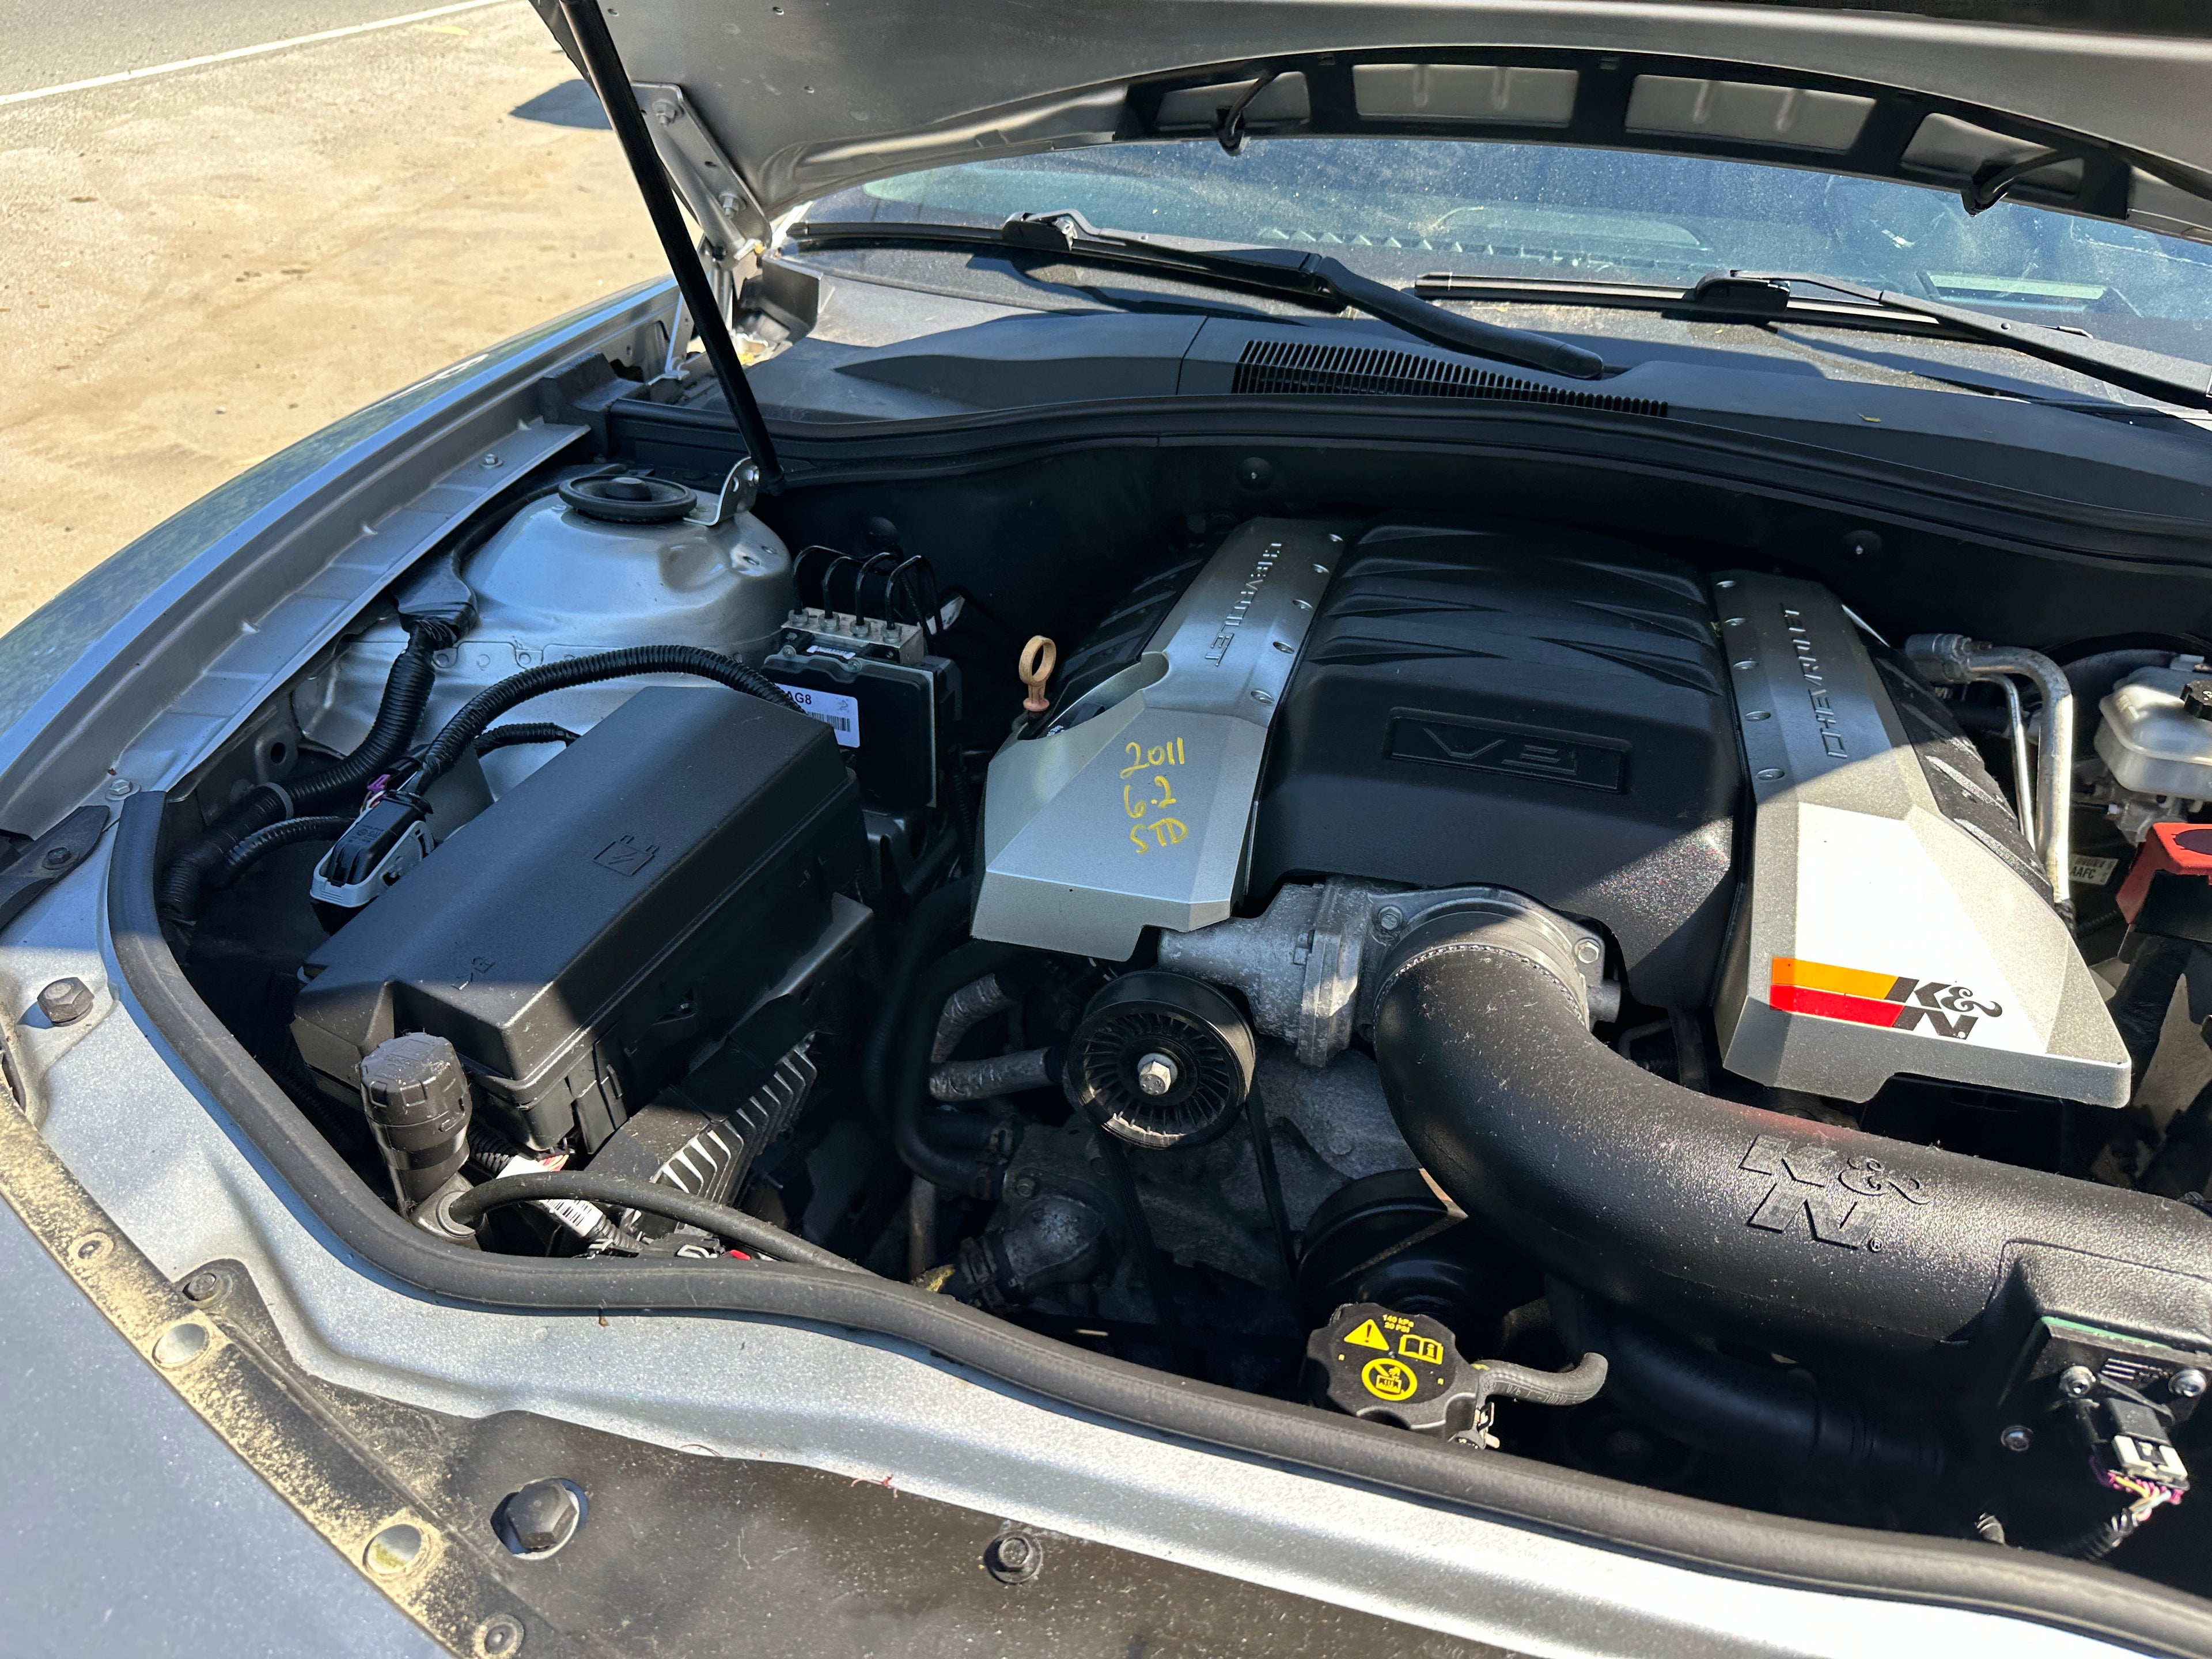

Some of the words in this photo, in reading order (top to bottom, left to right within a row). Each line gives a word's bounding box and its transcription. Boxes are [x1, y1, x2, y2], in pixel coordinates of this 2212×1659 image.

[1205, 543, 1282, 667] CHEVROLET
[1779, 603, 1848, 759] CHEVROLET
[1120, 737, 1184, 779] 2011
[1124, 775, 1176, 819] 6.2
[1129, 817, 1188, 854] STD
[1884, 976, 2003, 1040] K&N
[1382, 1314, 1397, 1323] 140
[1384, 1321, 1395, 1330] 20
[1395, 1324, 1410, 1333] PSI
